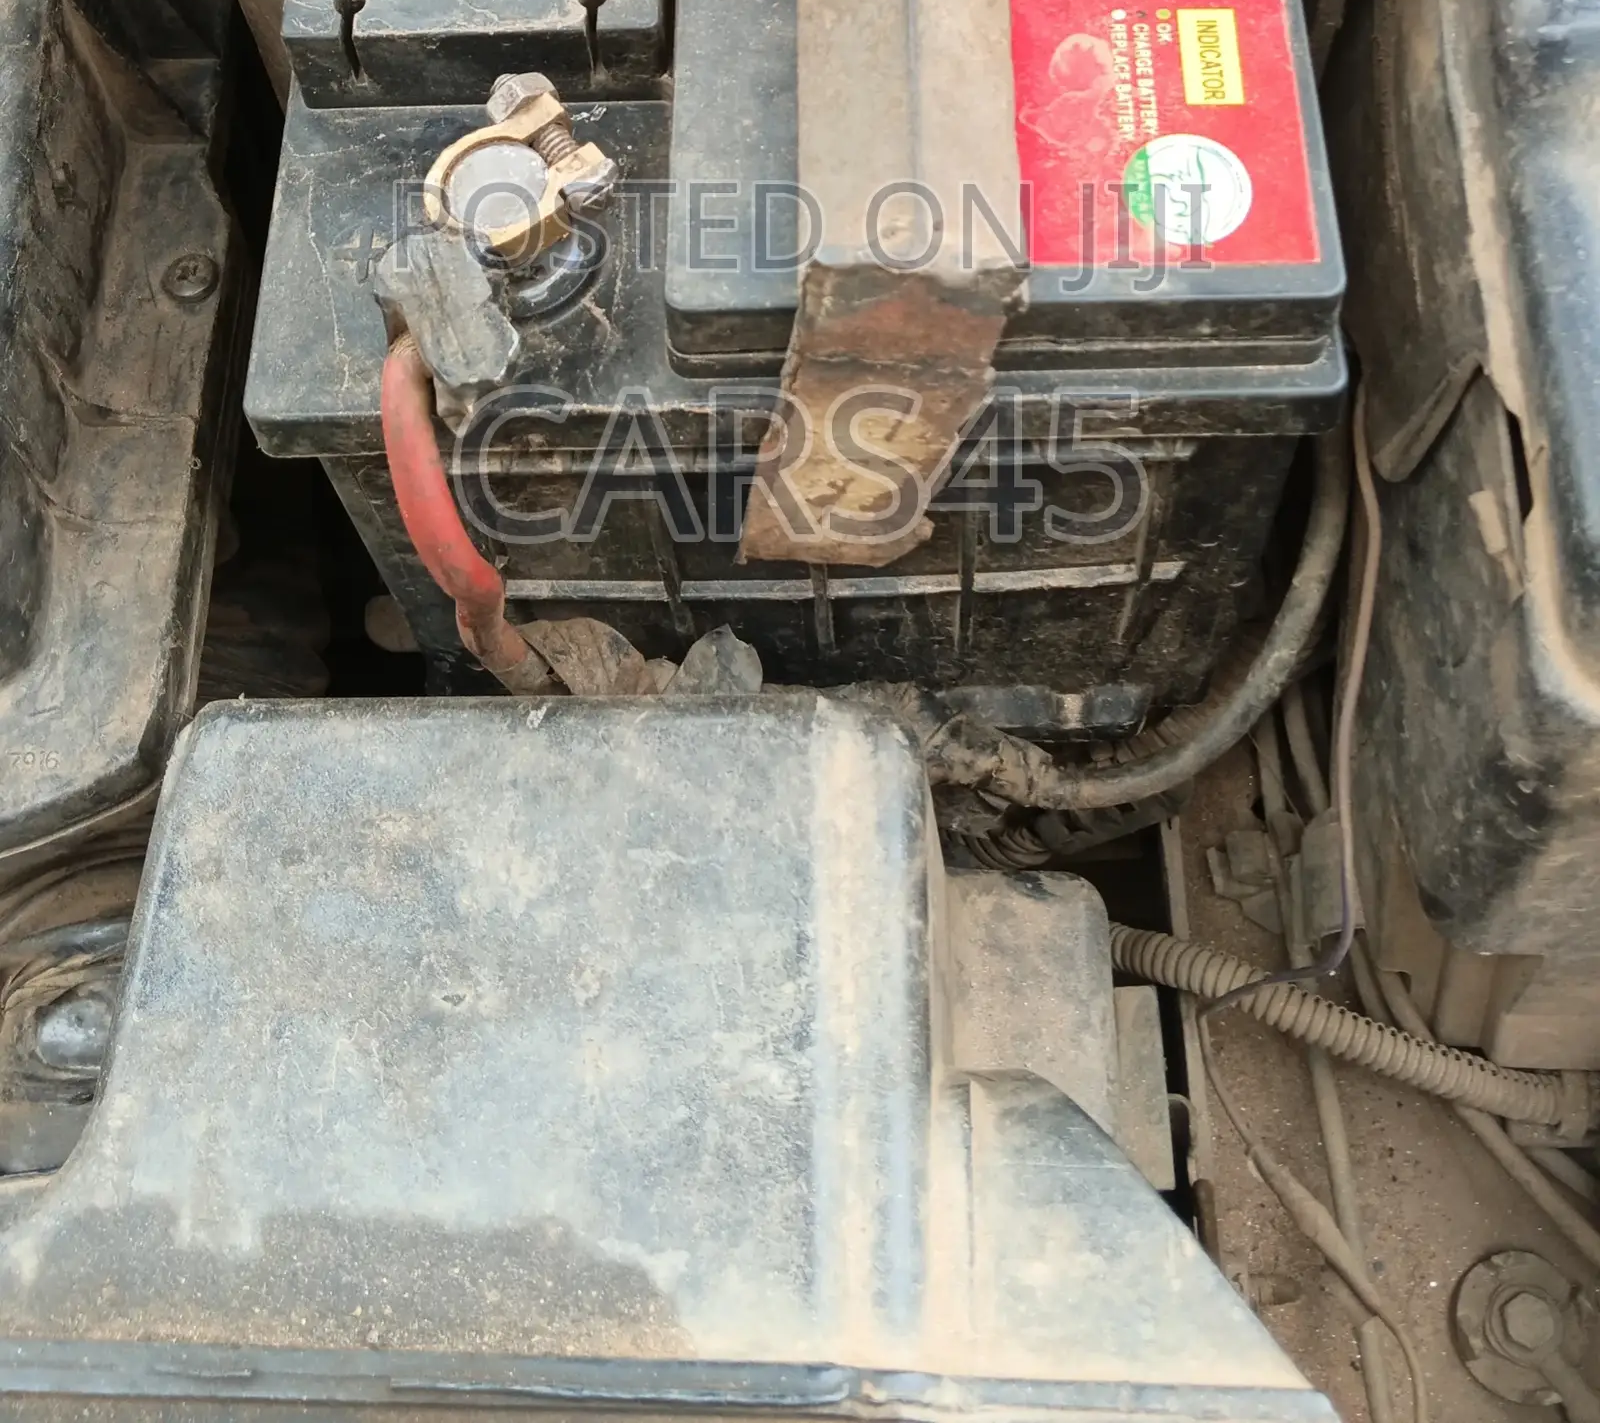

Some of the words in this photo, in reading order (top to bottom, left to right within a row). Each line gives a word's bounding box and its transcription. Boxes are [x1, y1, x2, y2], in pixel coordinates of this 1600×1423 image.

[1108, 24, 1132, 81] REPLACE
[1132, 23, 1155, 77] CHARGE
[1156, 22, 1173, 42] OK
[1196, 19, 1227, 101] INDICATOR
[1114, 83, 1136, 142] BATTERY
[1137, 78, 1159, 137] BATTERY
